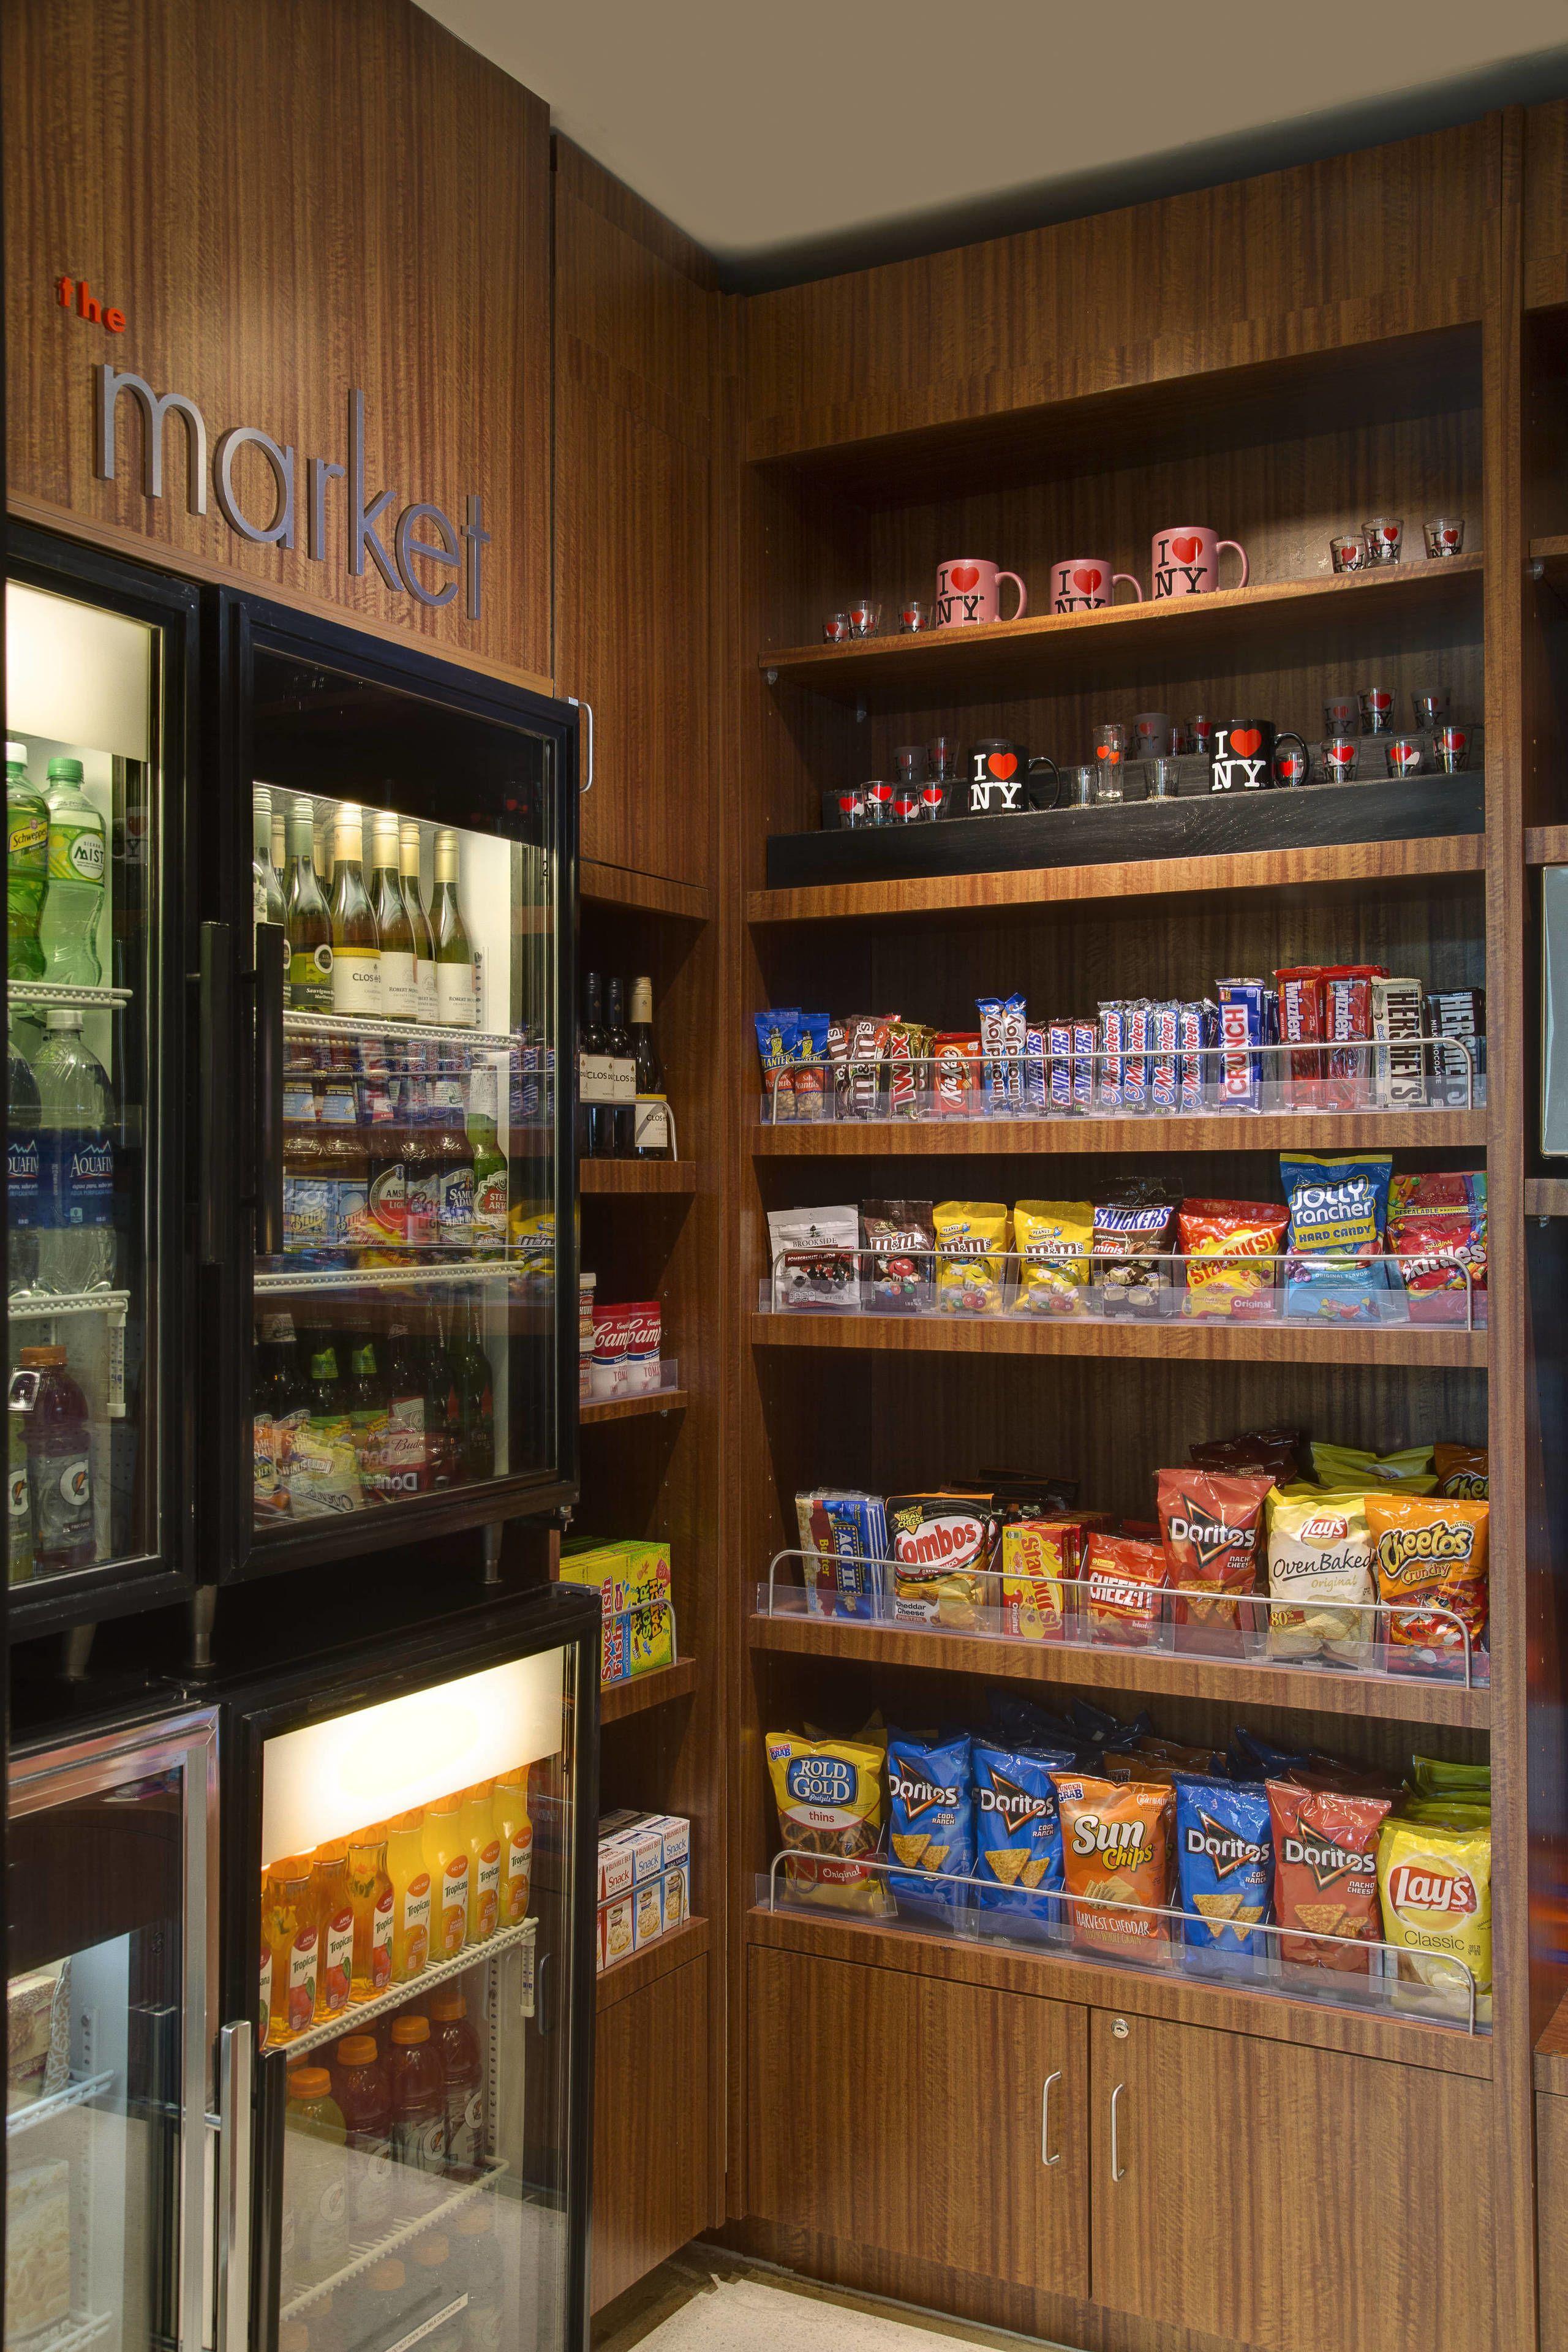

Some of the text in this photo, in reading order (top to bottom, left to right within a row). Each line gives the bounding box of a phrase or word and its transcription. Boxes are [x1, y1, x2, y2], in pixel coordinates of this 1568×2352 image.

[59, 276, 126, 333] the
[97, 364, 491, 620] market
[1158, 539, 1170, 568] I
[939, 570, 949, 596] I
[1057, 570, 1071, 596] I
[1155, 567, 1208, 600] NY
[937, 595, 984, 625] NY
[1215, 731, 1227, 760] I
[974, 754, 987, 782] I
[1212, 760, 1267, 791] NY
[970, 782, 1022, 812] NY
[74, 846, 104, 864] MIST
[353, 973, 374, 981] CLOS
[984, 1014, 1005, 1049] Joy
[1005, 1014, 1022, 1046] Joy
[1224, 1008, 1247, 1095] CRUNCH
[1387, 993, 1422, 1101] HERSHEY'S
[587, 1071, 607, 1080] CLOS
[1432, 1043, 1442, 1084] HOCOLATE
[647, 1114, 662, 1122] CLOS
[1291, 1179, 1365, 1212] JOLLY
[1093, 1207, 1172, 1231] SNICKERS
[1295, 1200, 1373, 1226] rancher
[1395, 1207, 1439, 1216] RESEALABLE
[793, 1238, 837, 1248] BROOKSIDE
[1298, 1225, 1372, 1243] HARD CANDY
[1094, 1244, 1125, 1254] minis
[1234, 1299, 1272, 1310] Original
[898, 1517, 924, 1529] CHEESE
[900, 1512, 921, 1522] REAL
[895, 1523, 976, 1564] Combos
[1172, 1517, 1256, 1547] Doritos
[818, 1538, 830, 1577] Buter
[1378, 1521, 1474, 1578] Cheetos
[1273, 1548, 1373, 1578] Oven Baked
[1401, 1562, 1451, 1585] Crunchy
[1311, 1576, 1357, 1593] Original
[896, 1600, 926, 1610] Cheddar
[897, 1607, 925, 1616] Cheese
[612, 1623, 624, 1678] Fish
[768, 1744, 791, 1753] HUNGER
[771, 1749, 791, 1761] GRAB
[799, 1759, 848, 1780] ROLD
[793, 1777, 851, 1801] GOLD
[809, 1794, 832, 1803] Pretzels
[889, 1774, 957, 1805] Doritos
[1058, 1789, 1083, 1802] GRAB
[980, 1789, 1054, 1816] Doritos
[809, 1811, 835, 1823] thins
[666, 1839, 687, 1856] Snack
[1073, 1815, 1145, 1855] Sun
[1188, 1829, 1270, 1863] Doritos
[638, 1854, 659, 1872] Snack
[1102, 1844, 1153, 1871] Chips
[1286, 1839, 1376, 1873] Doritos
[608, 1870, 630, 1888] Snack
[823, 1866, 862, 1882] Original
[445, 1881, 468, 1898] Tropicana
[1348, 1887, 1375, 1896] CHEESE
[1395, 1868, 1470, 1912] Lay's
[375, 1916, 394, 1934] Tropica
[1076, 1909, 1150, 1936] HARVEST CHEDDAR
[1404, 1930, 1465, 1951] Classic
